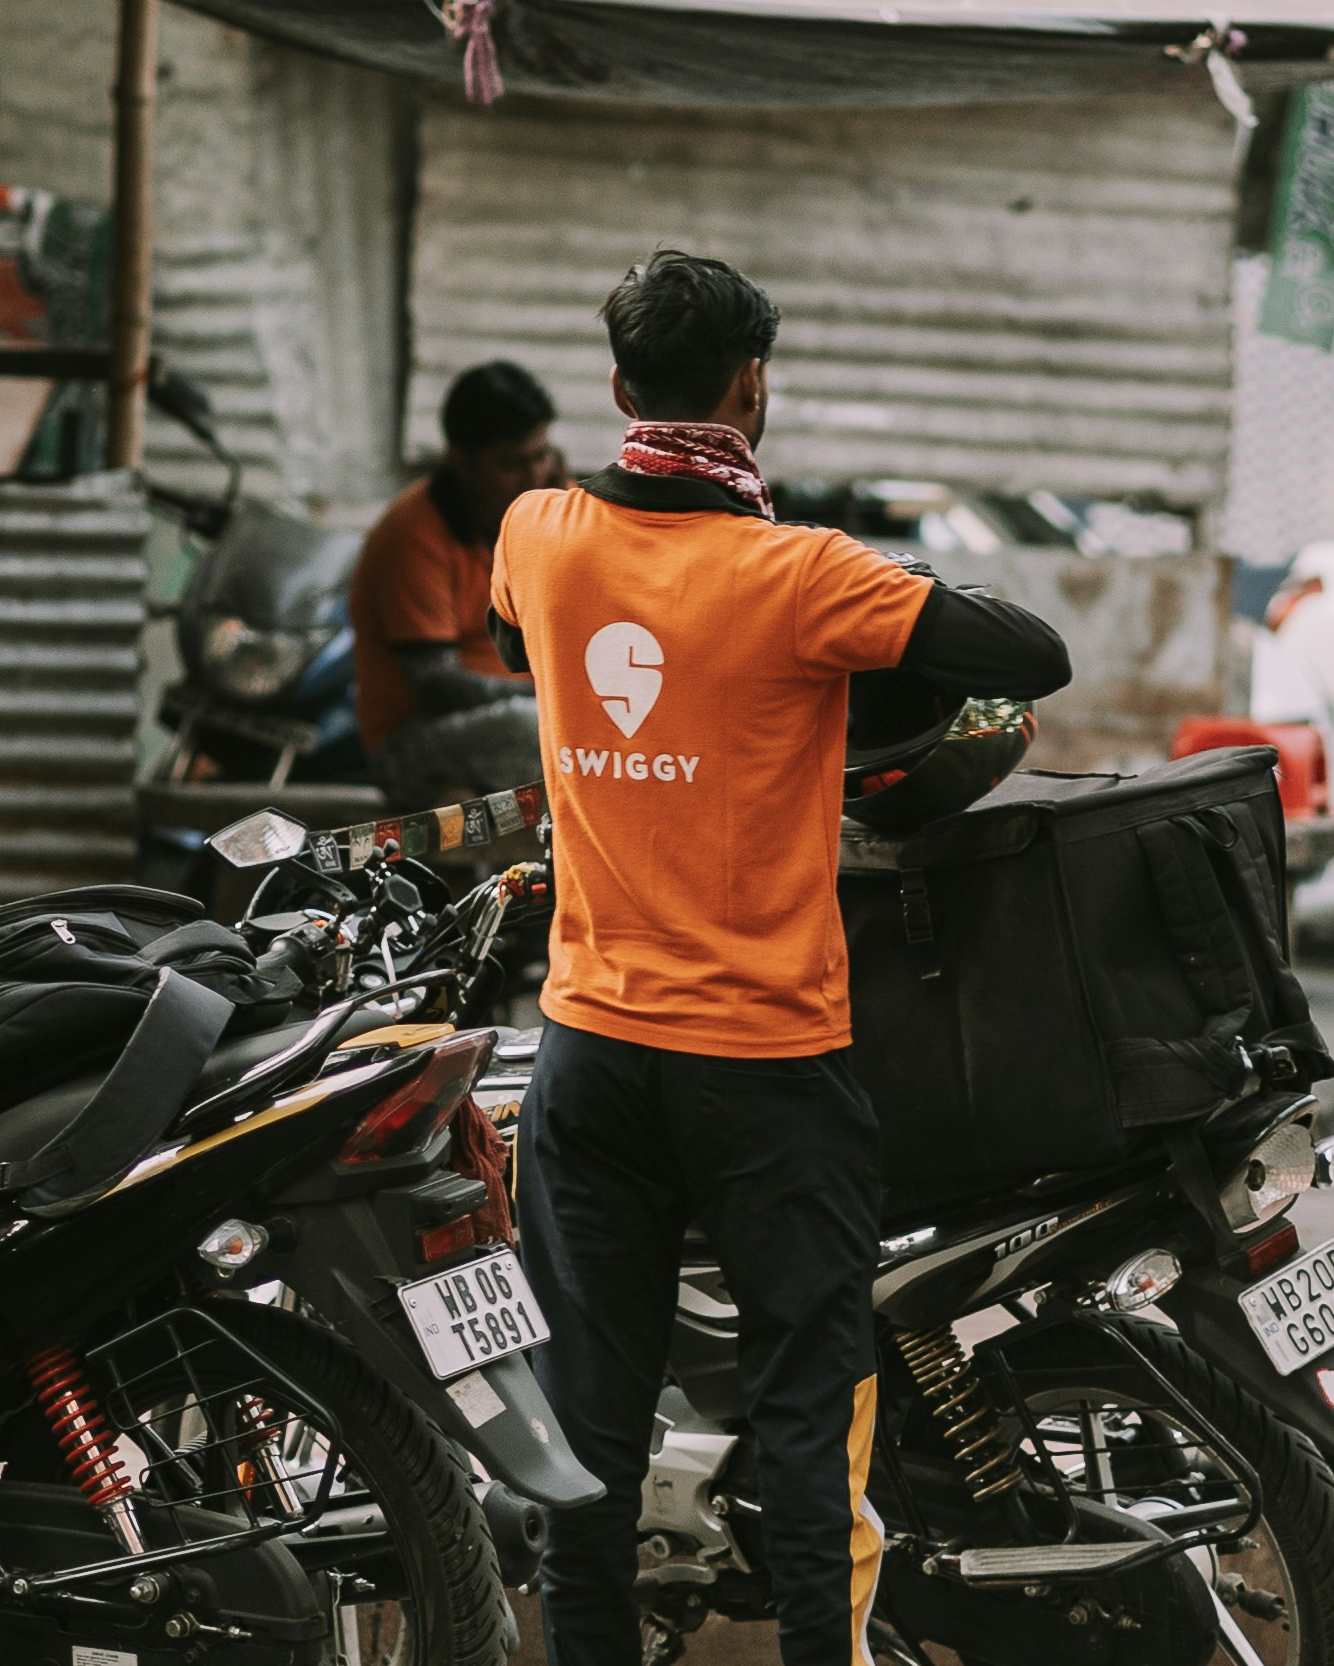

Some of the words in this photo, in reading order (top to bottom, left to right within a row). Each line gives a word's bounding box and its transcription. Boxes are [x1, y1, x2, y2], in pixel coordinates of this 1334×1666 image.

[559, 746, 701, 783] SWIGGY
[435, 1274, 478, 1320] WB
[474, 1261, 513, 1305] 06
[451, 1300, 537, 1362] T5891
